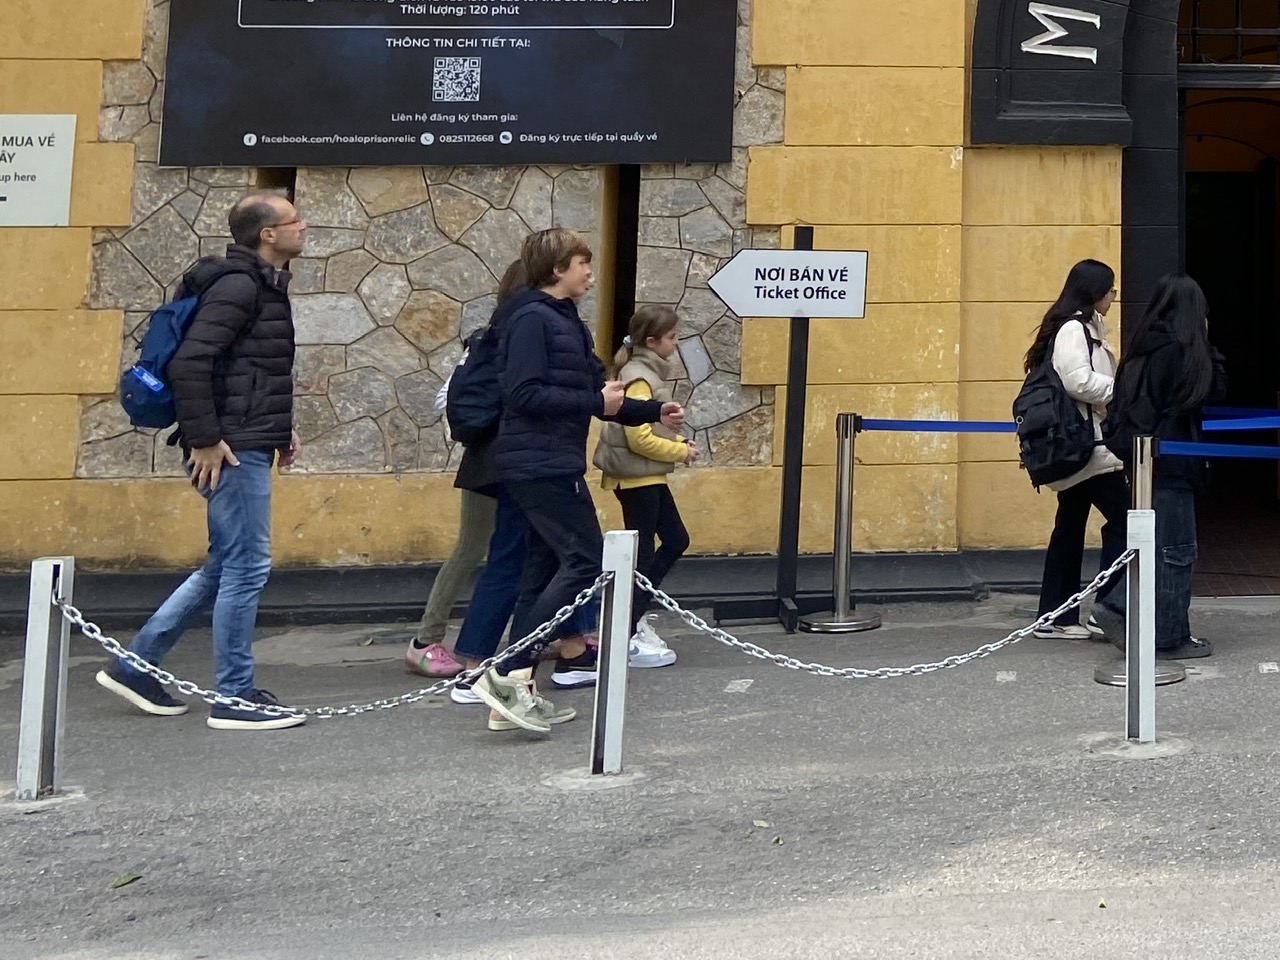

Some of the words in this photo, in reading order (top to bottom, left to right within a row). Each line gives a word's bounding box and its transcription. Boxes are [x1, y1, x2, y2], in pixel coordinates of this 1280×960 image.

[400, 4, 427, 15] Thời
[430, 4, 466, 16] lượng:
[469, 5, 489, 15] 120
[491, 5, 520, 16] phút
[386, 36, 430, 48] THÔNG
[433, 38, 453, 48] TIN
[456, 38, 477, 48] CHI
[480, 35, 506, 48] TIẾT
[509, 38, 531, 50] TẠI:
[391, 113, 413, 122] Liên
[415, 113, 427, 123] hệ
[430, 113, 456, 123] đăng
[458, 113, 469, 123] ký
[472, 112, 498, 122] tham
[500, 113, 518, 123] gia:
[2, 136, 34, 147] MUA
[261, 133, 416, 145] facebook.com/hoaloprisonrelic
[439, 134, 495, 144] 0825112668
[519, 133, 547, 143] Đăng
[549, 133, 560, 143] ký
[562, 133, 583, 144] trực
[584, 132, 604, 143] tiếp
[605, 132, 618, 143] tại
[0, 150, 16, 164] ÂY
[14, 172, 37, 182] here
[754, 267, 785, 281] NƠI
[790, 266, 824, 282] BÁN
[828, 267, 849, 282] VÉ
[754, 286, 799, 299] Ticket
[803, 286, 847, 300] Office
